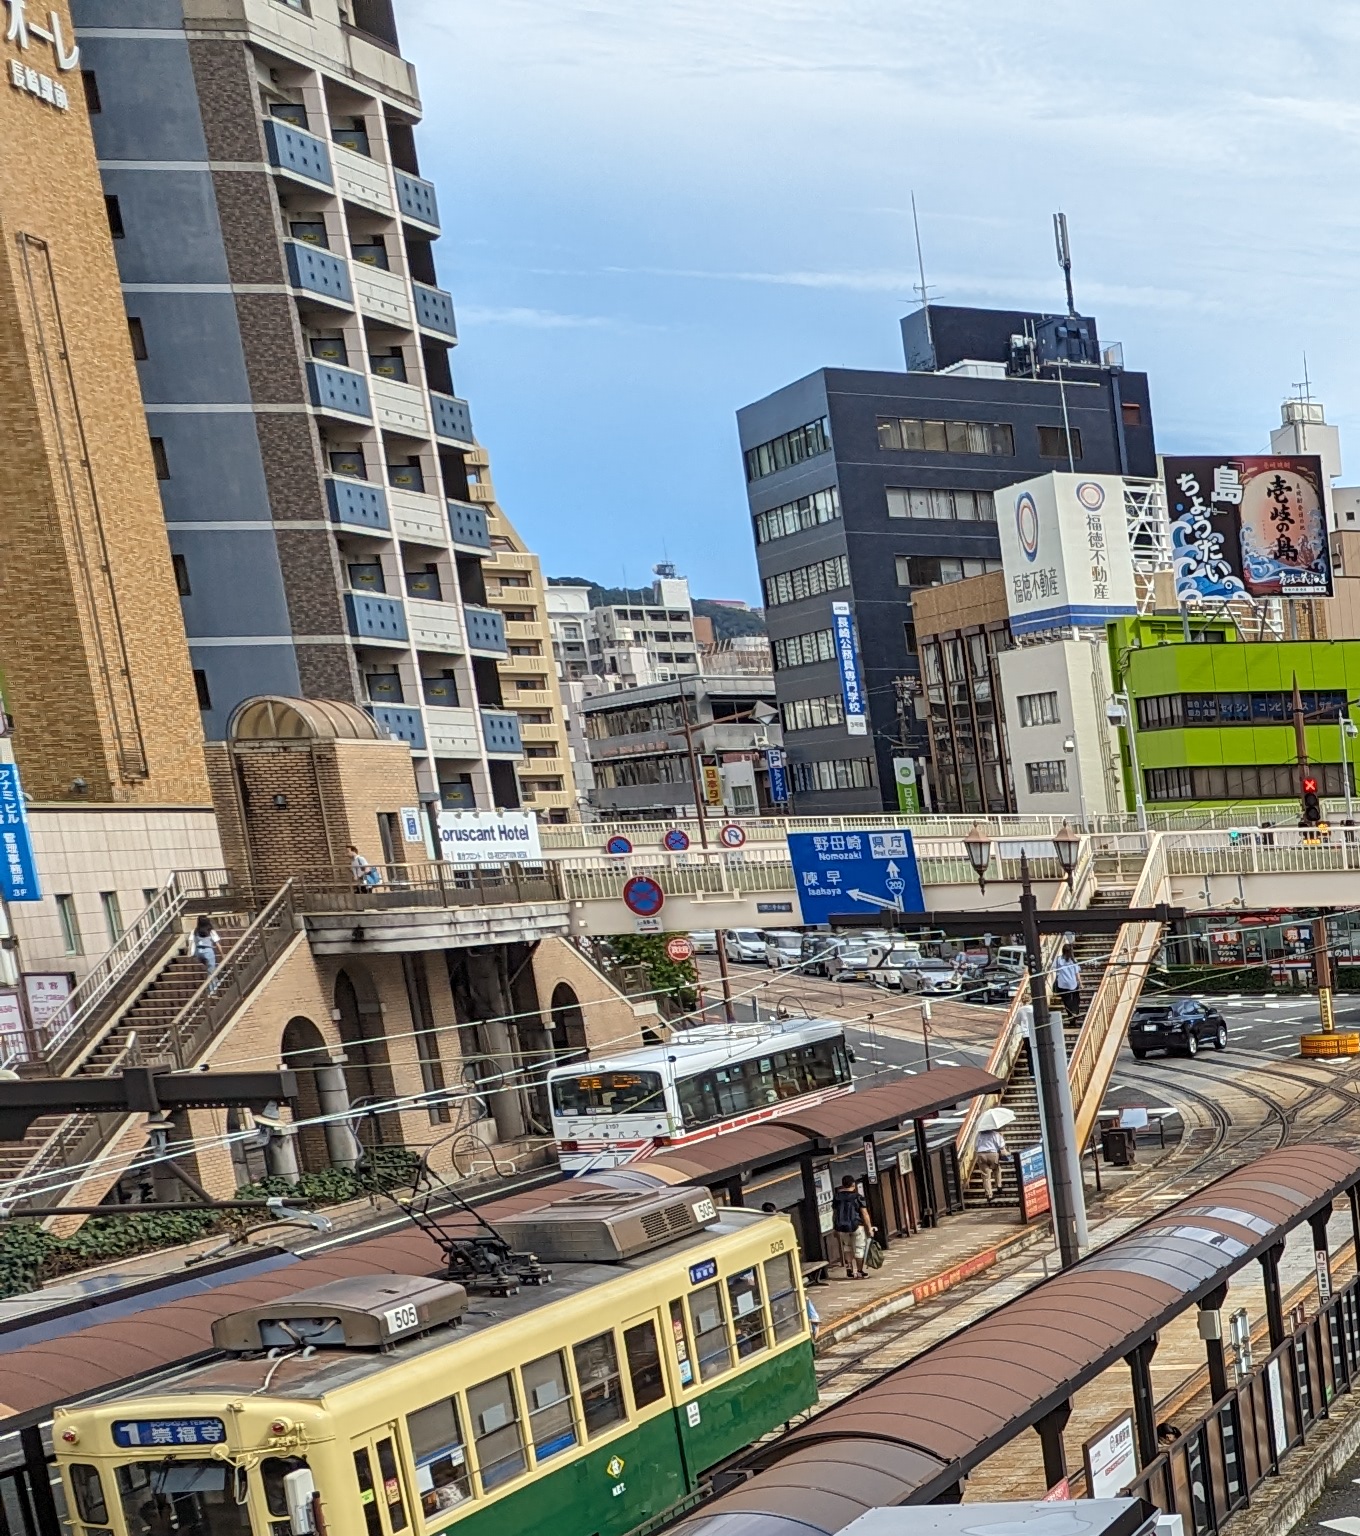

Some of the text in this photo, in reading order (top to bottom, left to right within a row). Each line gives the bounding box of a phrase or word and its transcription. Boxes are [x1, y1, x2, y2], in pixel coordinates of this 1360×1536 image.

[1267, 474, 1299, 562] 壱岐の島
[1086, 514, 1110, 600] 福徳不動産
[1012, 566, 1060, 603] 福徳不動産
[837, 616, 862, 714] 長崎公務員専門学校
[771, 756, 780, 765] P
[498, 825, 530, 841] Hotel
[813, 835, 862, 852] 野母崎
[872, 835, 905, 849] 県庁
[819, 851, 862, 861] Nomozaki
[802, 870, 843, 887] 諫早
[889, 880, 903, 890] 202
[808, 888, 842, 897] Isahaya
[698, 1202, 716, 1219] 505
[395, 1304, 417, 1330] 505
[120, 1422, 223, 1445] 1 崇福寺
